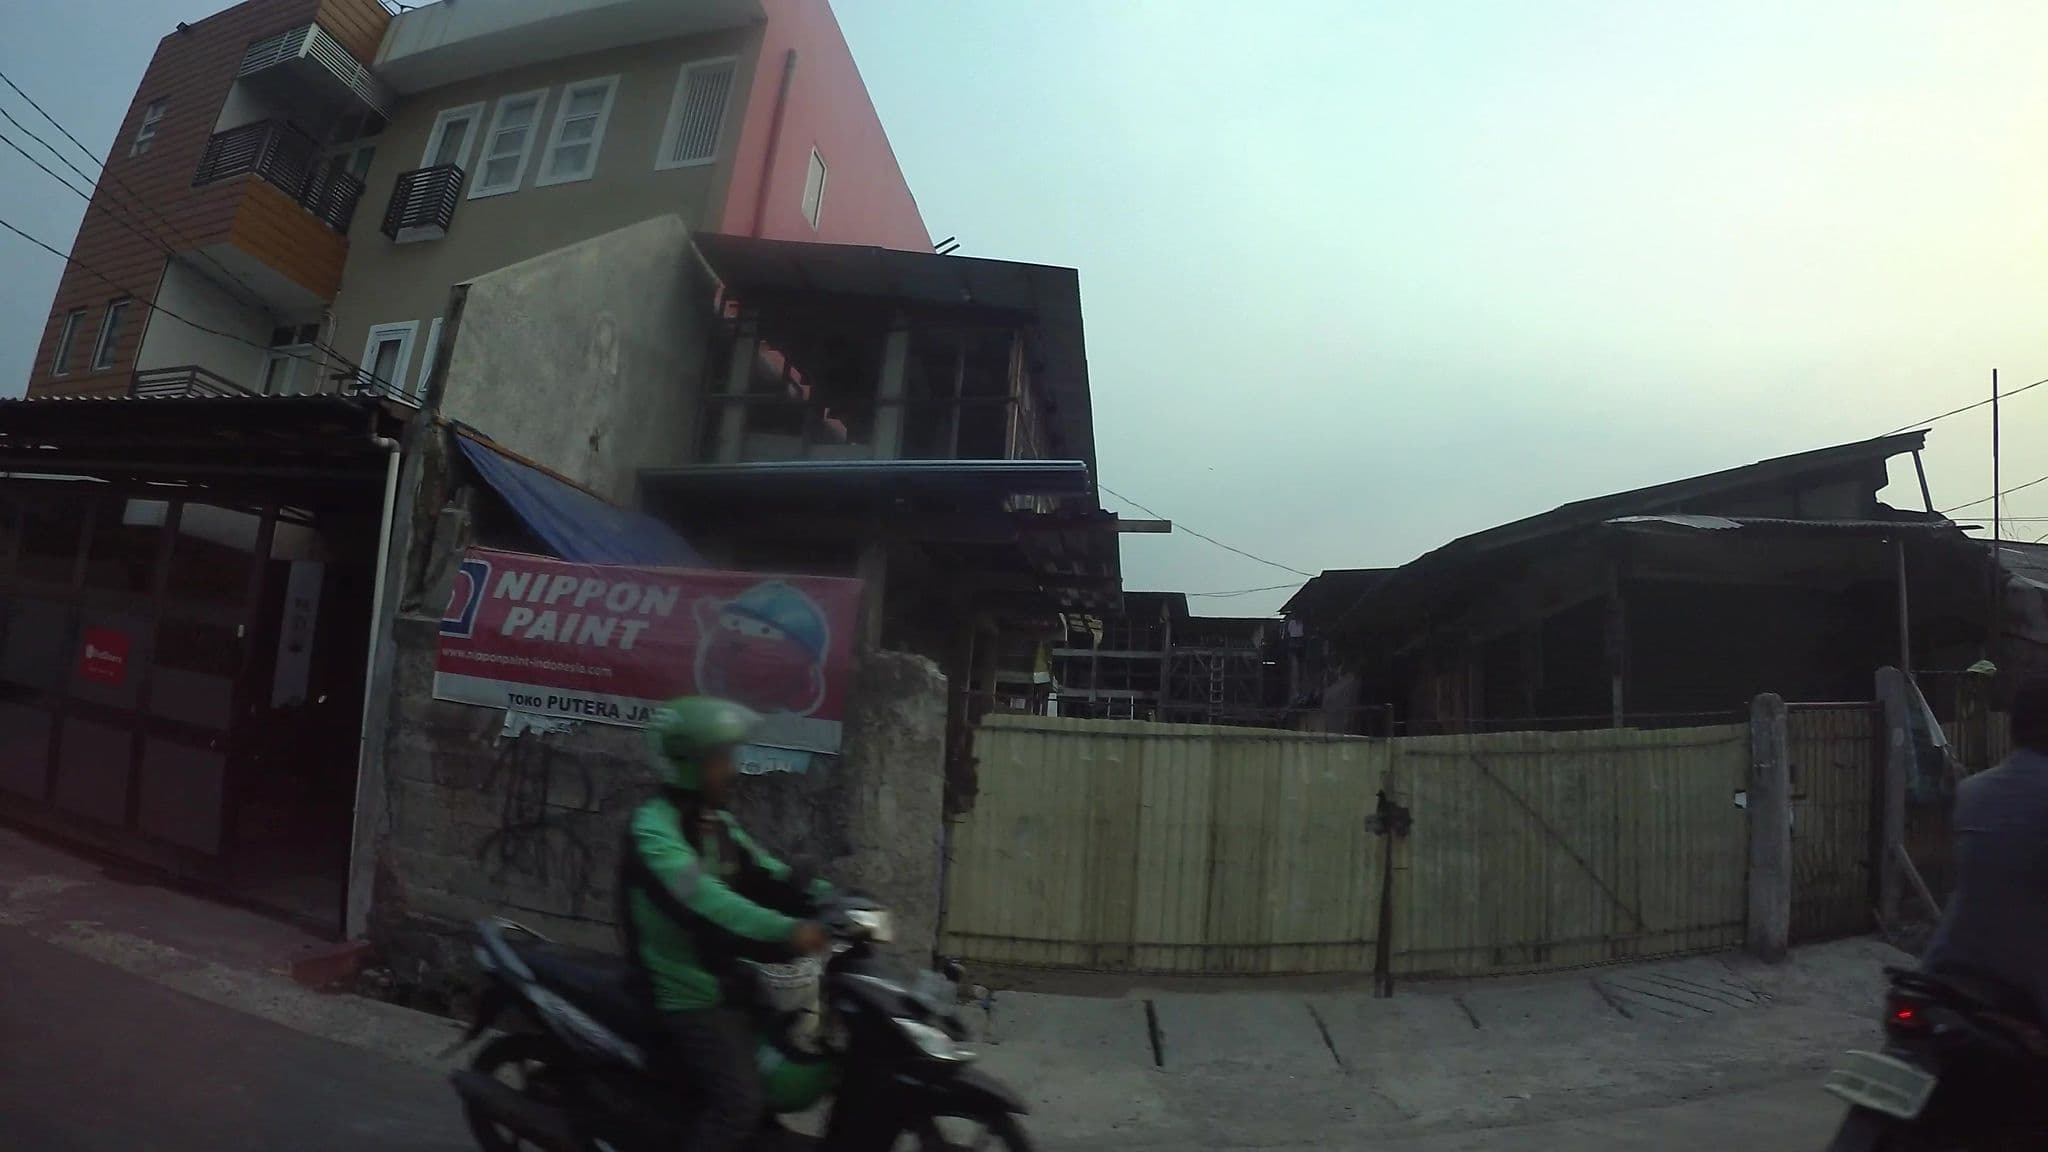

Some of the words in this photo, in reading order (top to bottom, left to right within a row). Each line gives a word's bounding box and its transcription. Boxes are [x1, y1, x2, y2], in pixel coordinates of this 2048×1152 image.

[493, 570, 681, 617] NIPPON
[501, 606, 650, 650] PAINT
[442, 648, 612, 677] www.nipponpaint-indonesia.com
[508, 693, 542, 708] TOKO
[547, 695, 620, 719] PUTERA
[626, 705, 656, 722] JA
